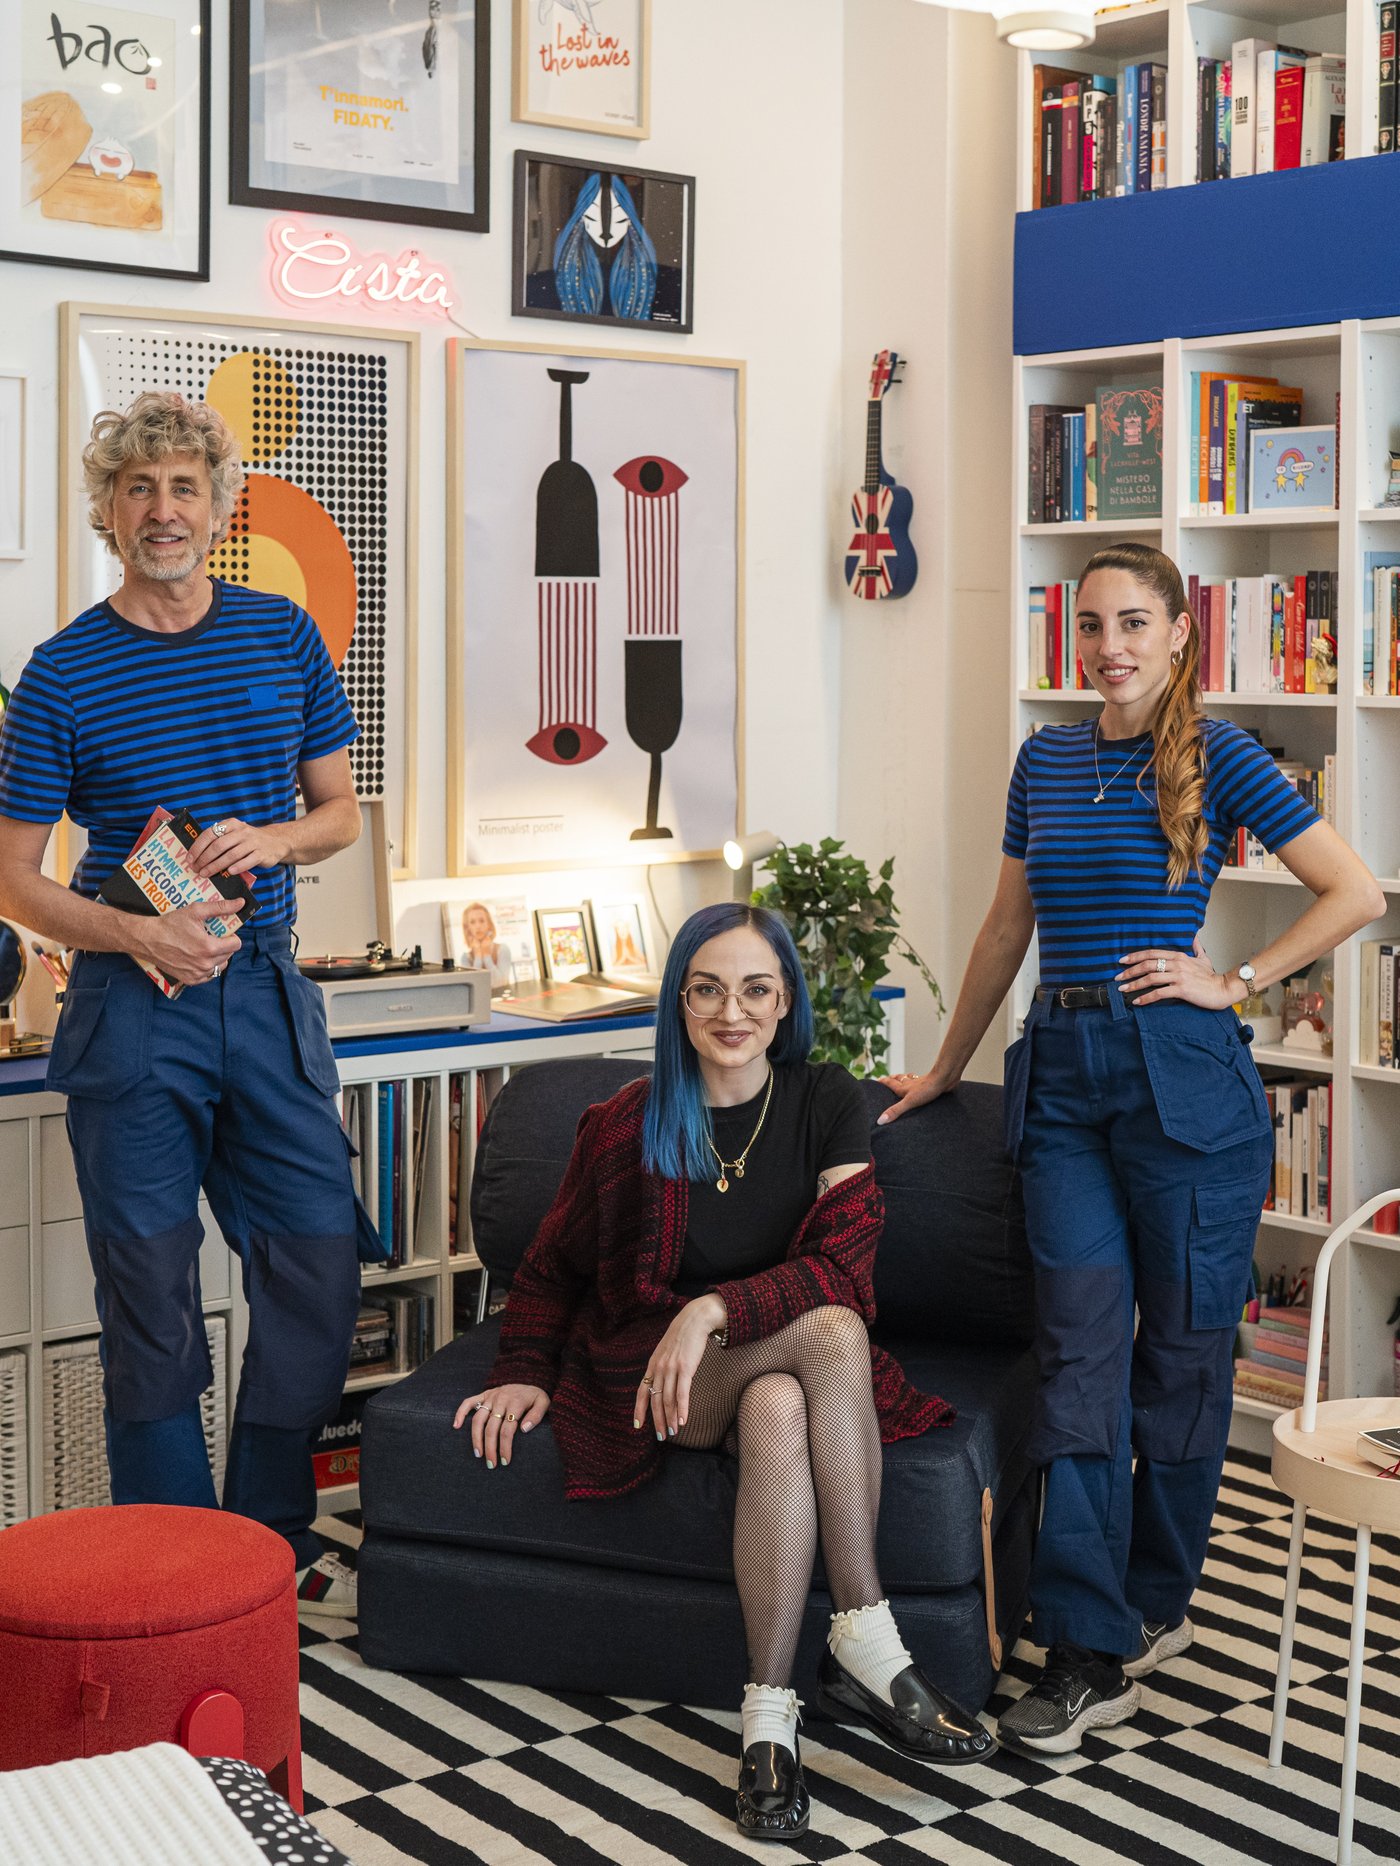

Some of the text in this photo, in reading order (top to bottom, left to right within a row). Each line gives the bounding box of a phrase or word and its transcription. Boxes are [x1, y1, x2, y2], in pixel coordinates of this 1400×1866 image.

[46, 12, 152, 75] bao
[556, 22, 620, 51] Lost in
[539, 43, 631, 76] the waves
[319, 85, 409, 112] T'innamori.
[1235, 96, 1248, 111] 100
[333, 109, 394, 131] FIDATY.
[1242, 403, 1255, 414] ET
[1109, 485, 1157, 495] NELLA CASA
[1115, 474, 1150, 484] MISTERO
[1109, 495, 1157, 505] DI BAMBOLE
[478, 822, 564, 837] Minimalist poster
[147, 838, 183, 880] HYMNE
[178, 878, 191, 892] A
[158, 828, 176, 849] LA
[193, 874, 212, 893] EN
[126, 858, 172, 913] LES TROIS
[136, 848, 189, 910] L'ACCORDE
[297, 875, 320, 884] ATE
